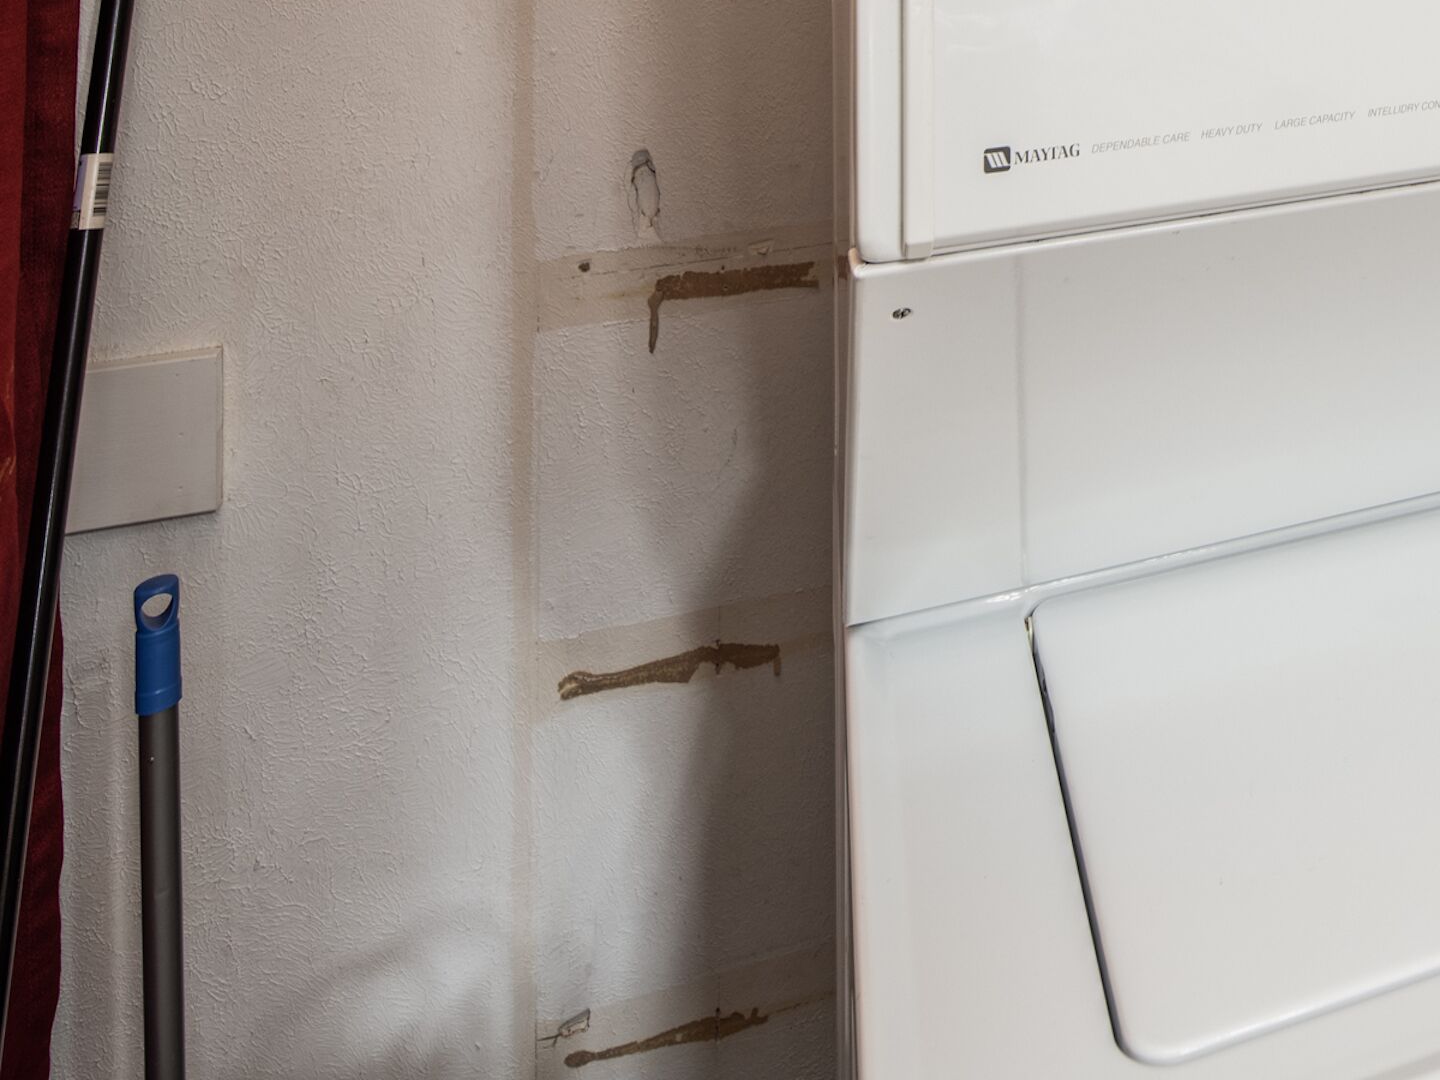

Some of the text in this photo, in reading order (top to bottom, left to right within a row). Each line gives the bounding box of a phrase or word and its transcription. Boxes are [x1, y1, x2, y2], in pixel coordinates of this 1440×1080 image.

[1091, 135, 1161, 154] DEPENDABLE
[1162, 131, 1192, 145] CARE
[1201, 125, 1234, 140] HEAVY
[1235, 122, 1264, 136] DUTY
[1273, 116, 1308, 131] LARGE
[1308, 110, 1358, 127] CAPACITY
[1367, 102, 1421, 119] INTELLIDRY
[1014, 143, 1081, 165] MAYTAG
